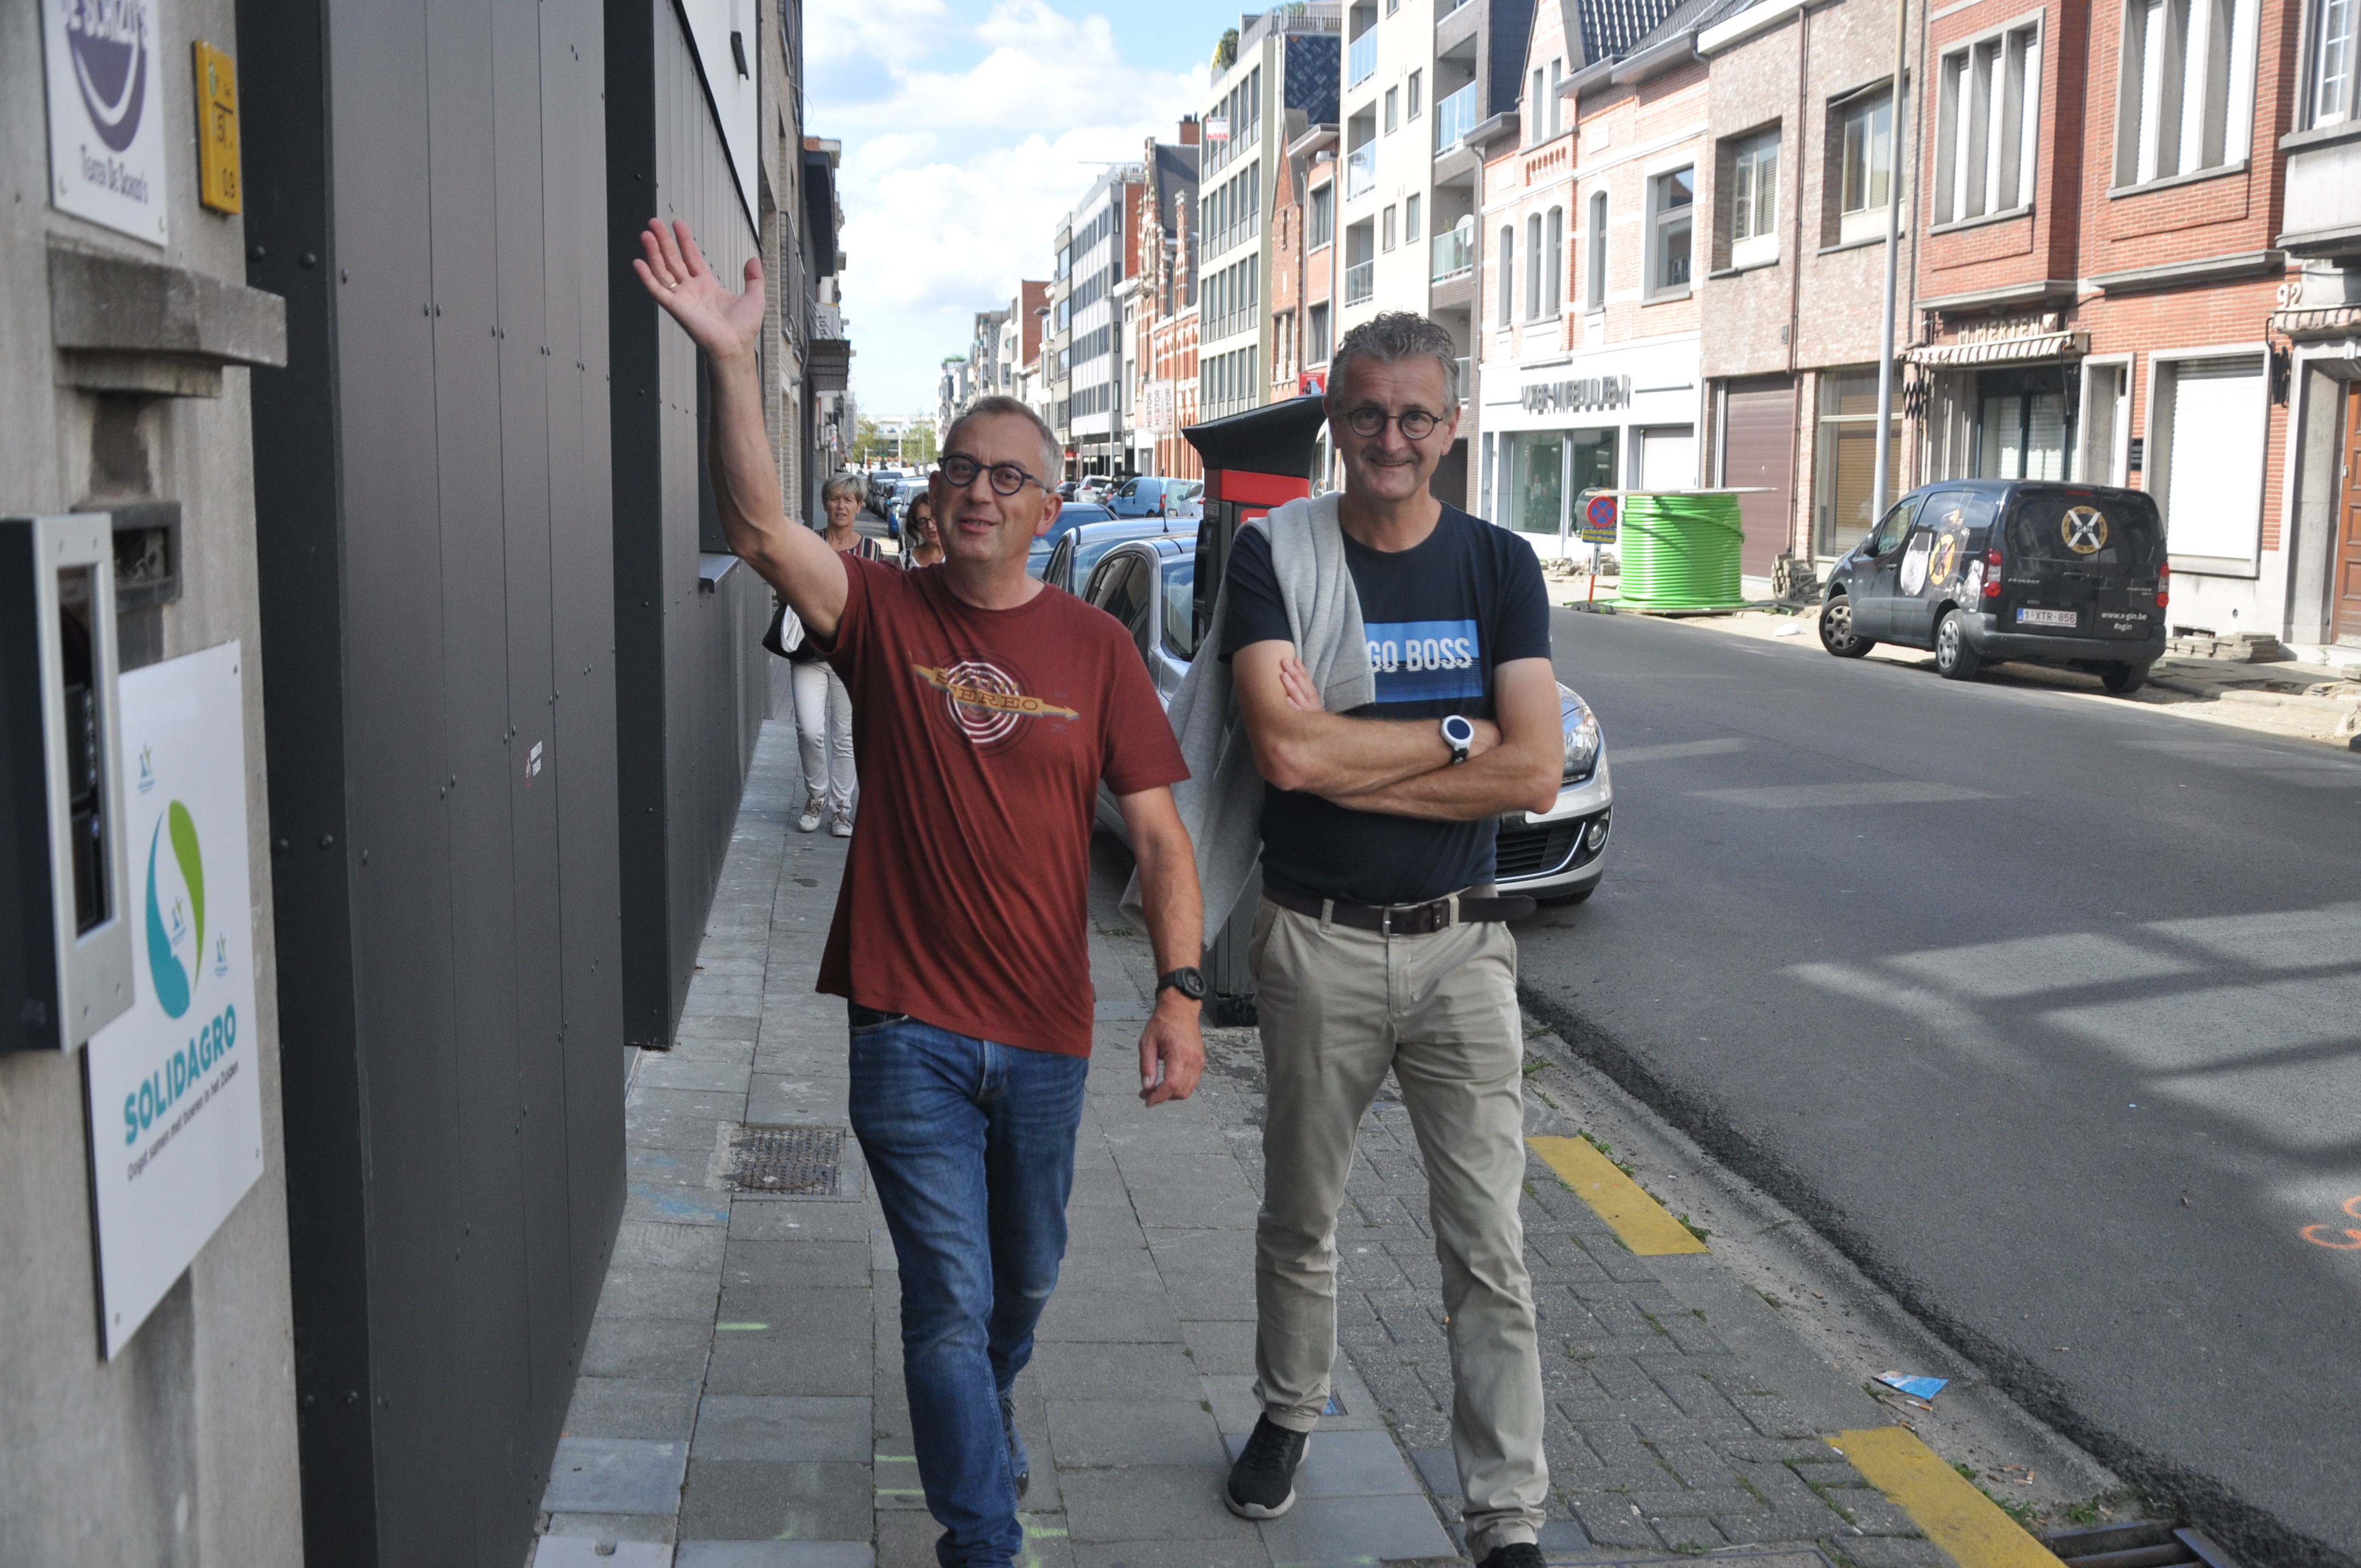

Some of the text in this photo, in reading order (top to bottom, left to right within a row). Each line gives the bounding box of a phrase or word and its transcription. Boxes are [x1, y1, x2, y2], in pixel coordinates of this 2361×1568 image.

[2276, 282, 2302, 310] 92
[1521, 374, 1630, 415] VERMEULEN
[2025, 610, 2075, 623] 1-XTR-856
[2101, 612, 2147, 621] www.x-gin.be
[2114, 622, 2132, 631] #xgin
[1367, 638, 1472, 673] GO BOSS
[124, 1003, 236, 1146] SOLIDAGRO
[149, 1130, 170, 1158] samen
[170, 1113, 182, 1137] met
[182, 1095, 203, 1124] boeren
[204, 1088, 210, 1103] in
[210, 1076, 220, 1096] het
[220, 1059, 238, 1087] Zuiden
